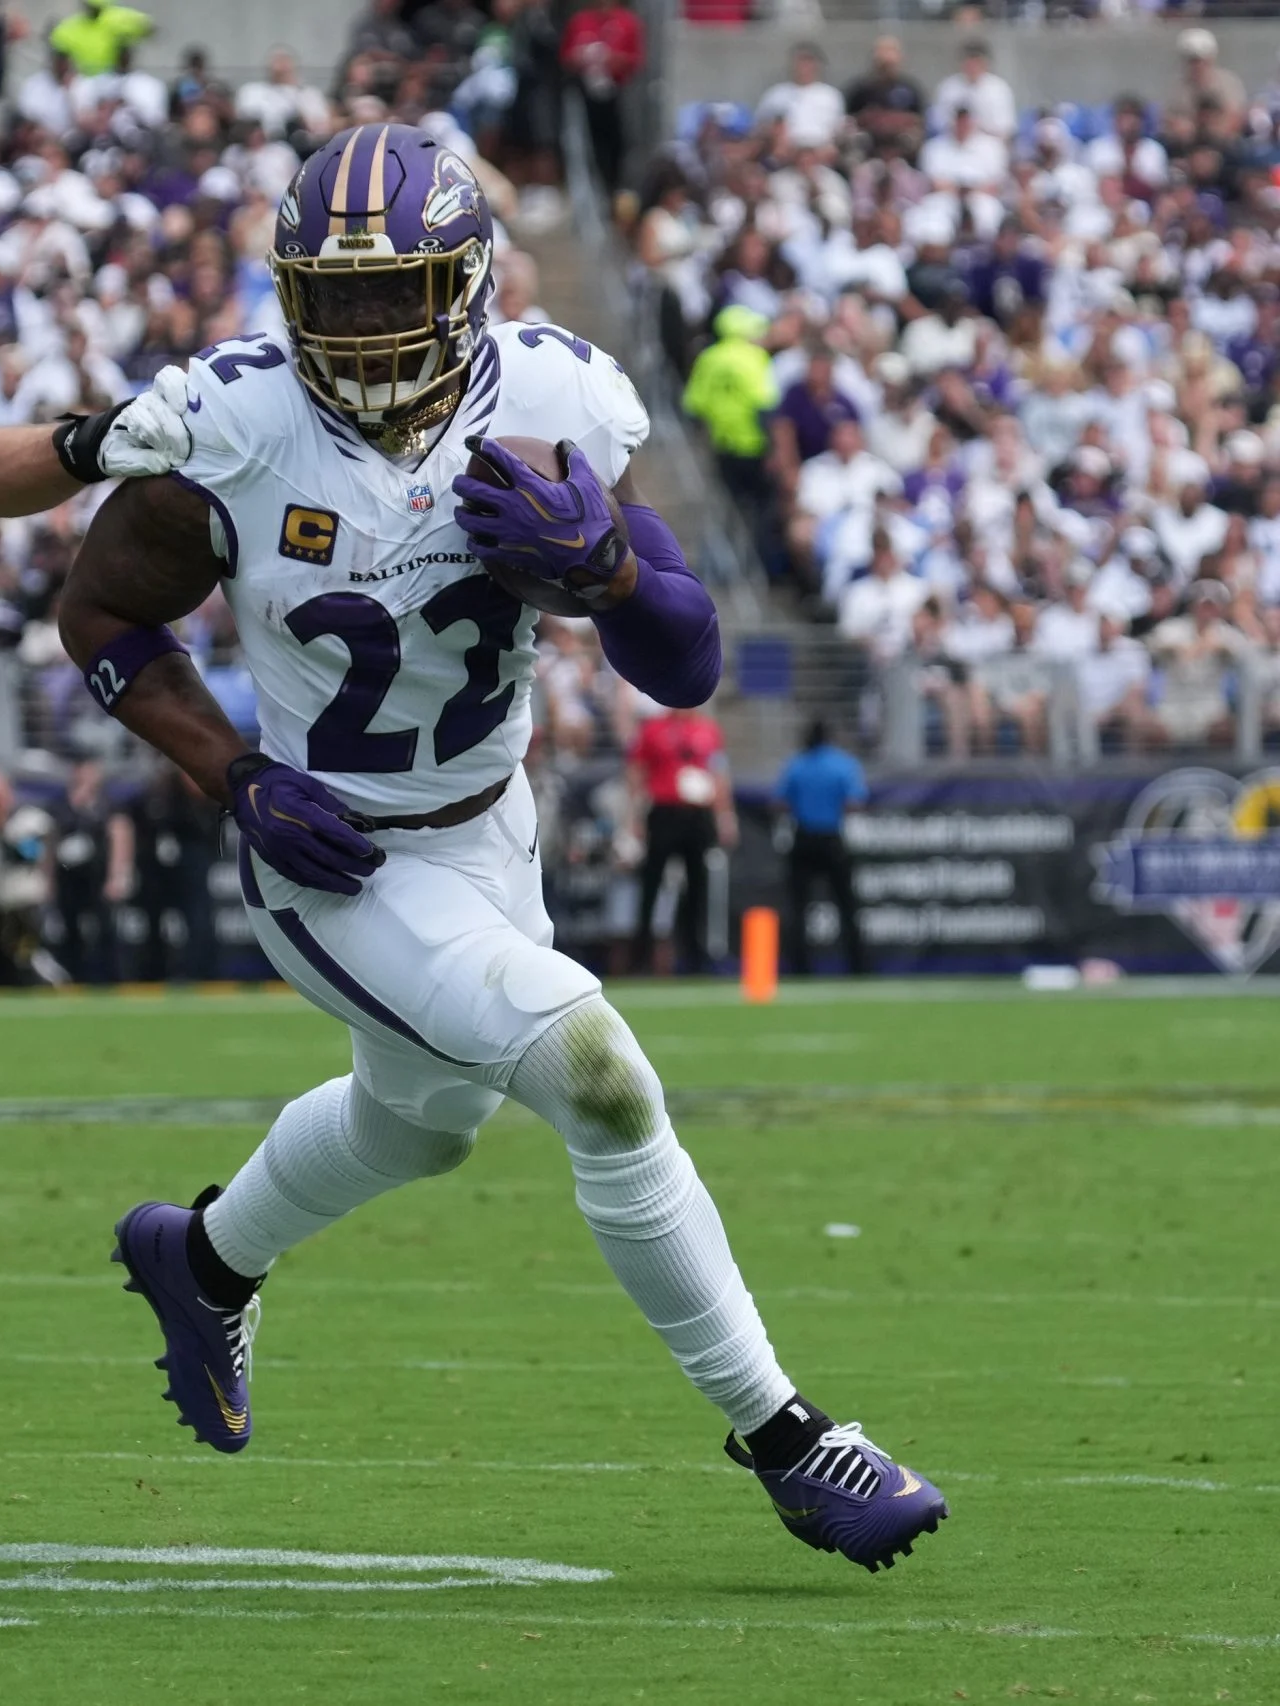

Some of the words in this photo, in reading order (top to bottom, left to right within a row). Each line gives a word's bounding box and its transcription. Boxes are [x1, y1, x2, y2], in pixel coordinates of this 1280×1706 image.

[337, 238, 375, 249] RAVENS
[410, 495, 433, 511] NFL
[285, 508, 334, 551] C
[348, 552, 476, 582] BALTIMORE
[90, 658, 126, 706] 22
[283, 572, 523, 773] 22
